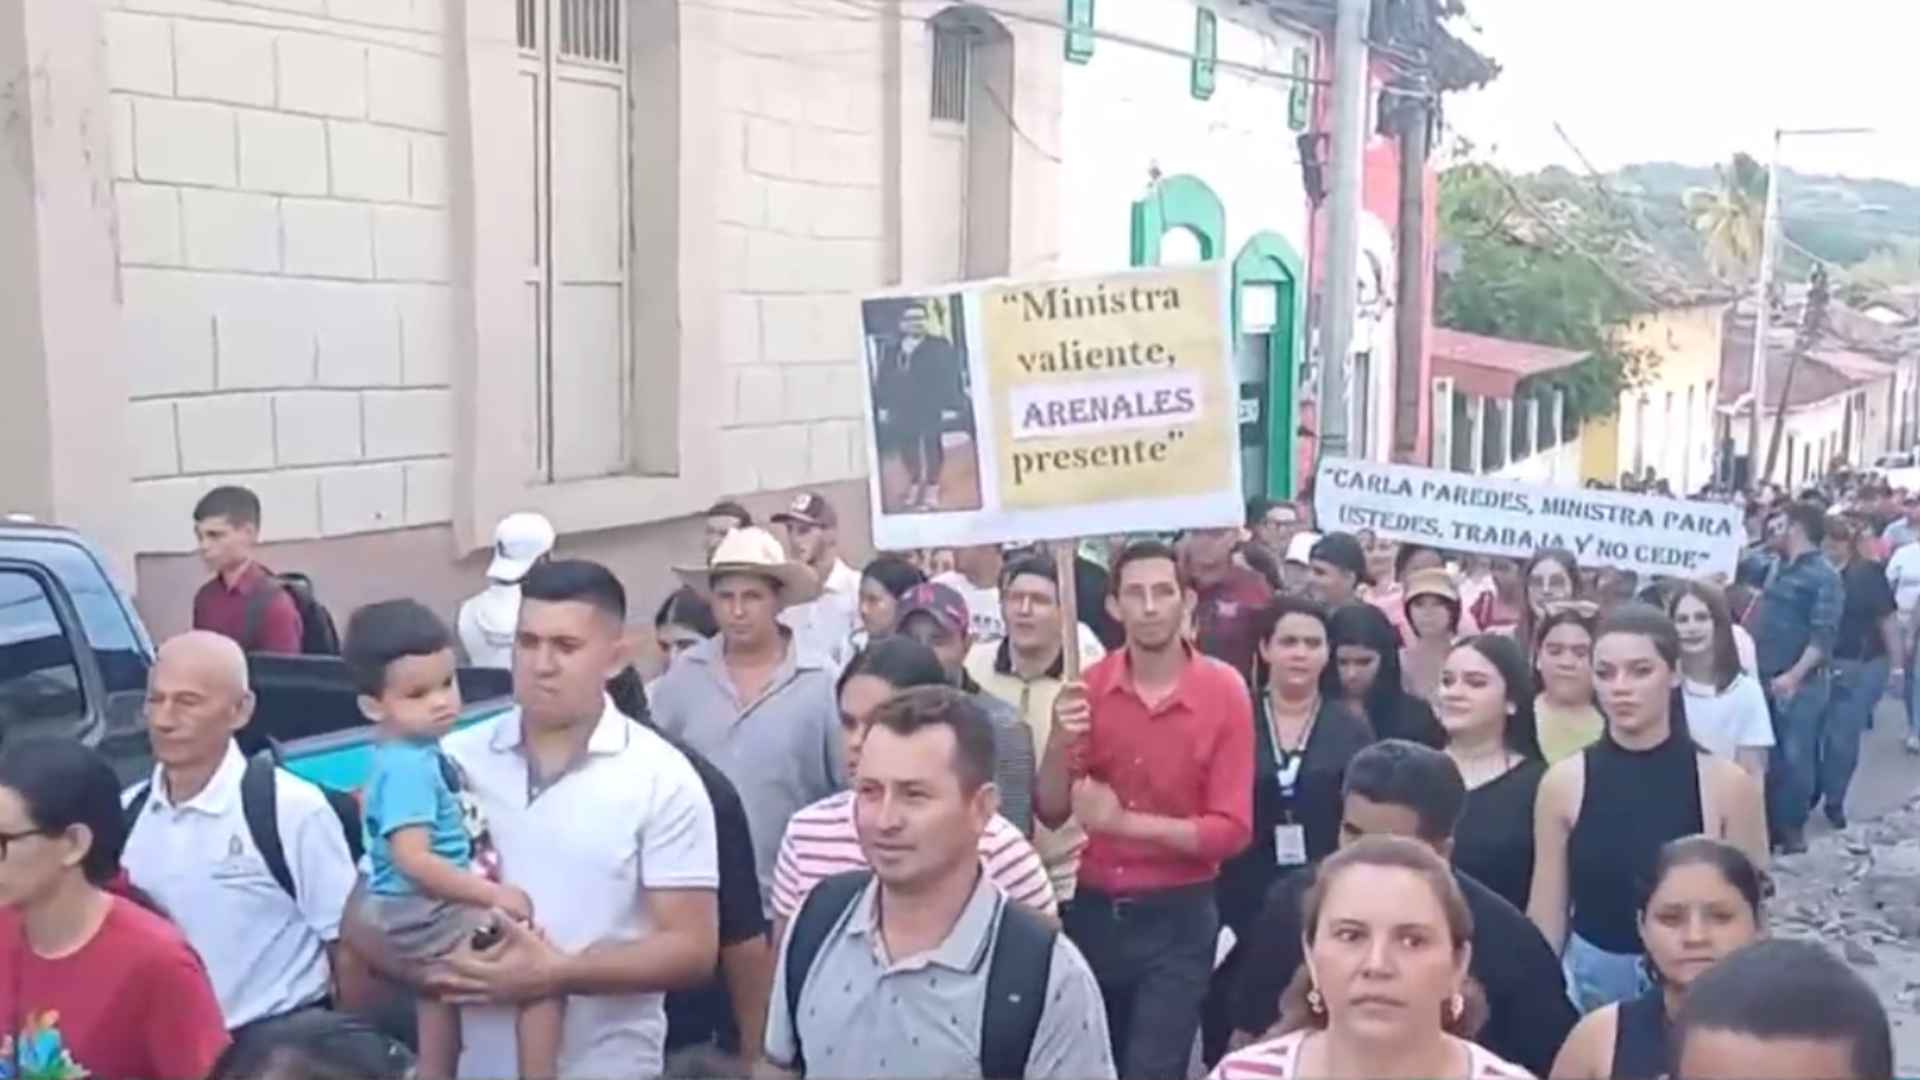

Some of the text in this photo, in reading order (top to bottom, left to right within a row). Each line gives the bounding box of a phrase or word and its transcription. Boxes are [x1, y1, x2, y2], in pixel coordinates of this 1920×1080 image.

[1018, 340, 1176, 373] valiente,
[1023, 388, 1194, 428] ARENALES
[1338, 504, 1443, 538] USTEDES,
[1450, 520, 1565, 550] TRABAJA
[1575, 533, 1594, 555] Y
[1597, 540, 1628, 561] NO
[1421, 481, 1533, 516] PAREDES,
[1541, 497, 1655, 528] MINISTRA
[1664, 511, 1732, 537] PARA
